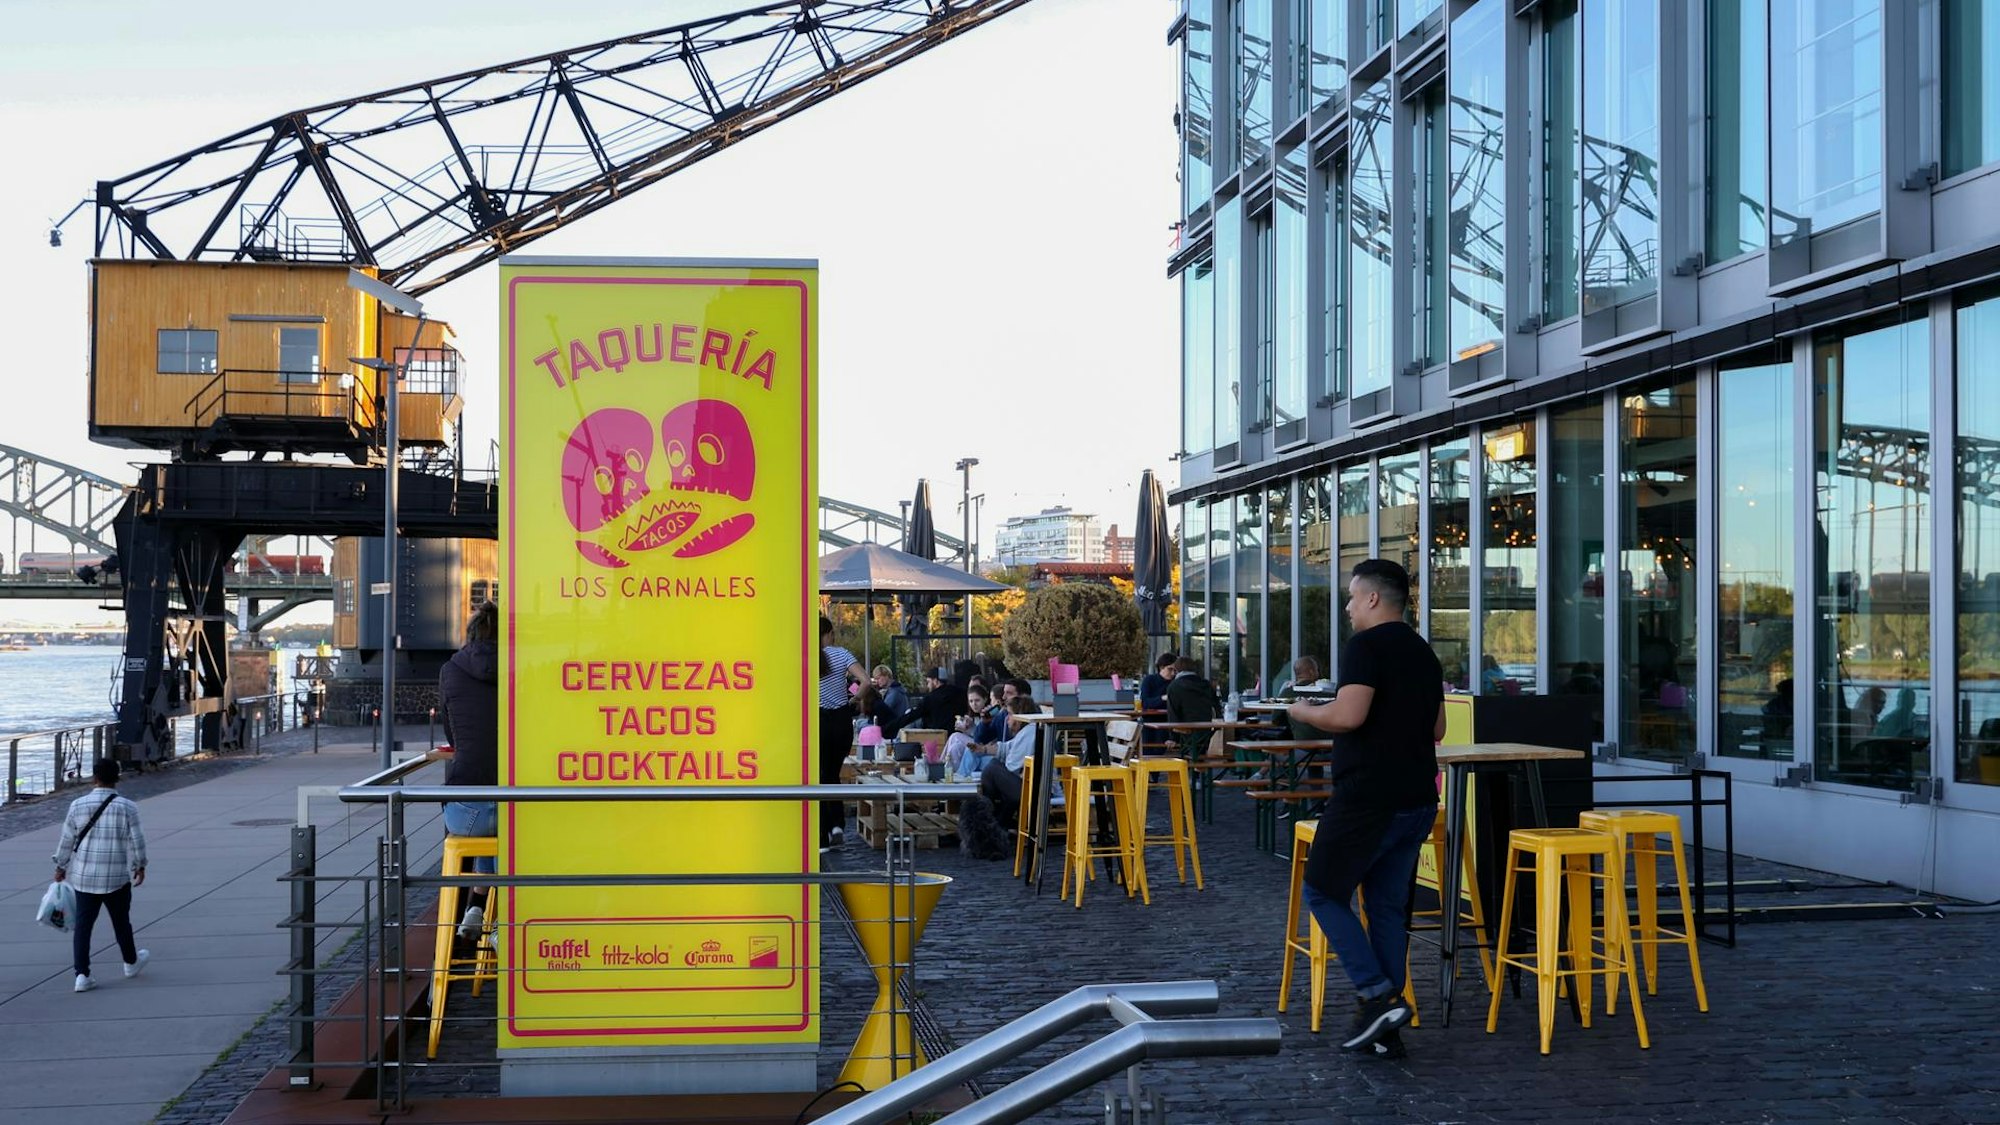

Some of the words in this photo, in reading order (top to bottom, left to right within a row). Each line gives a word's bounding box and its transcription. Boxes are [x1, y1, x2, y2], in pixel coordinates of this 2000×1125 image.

[534, 323, 777, 391] TAQUERÍA
[638, 514, 686, 549] TACOS
[560, 576, 607, 599] LOS
[620, 576, 757, 599] CARNALES
[562, 660, 755, 692] CERVEZAS
[598, 705, 718, 737] TACOS
[557, 749, 759, 782] COCKTAILS
[538, 938, 591, 960] Gaffel
[602, 944, 670, 966] fritz-kola
[684, 951, 734, 967] Corona
